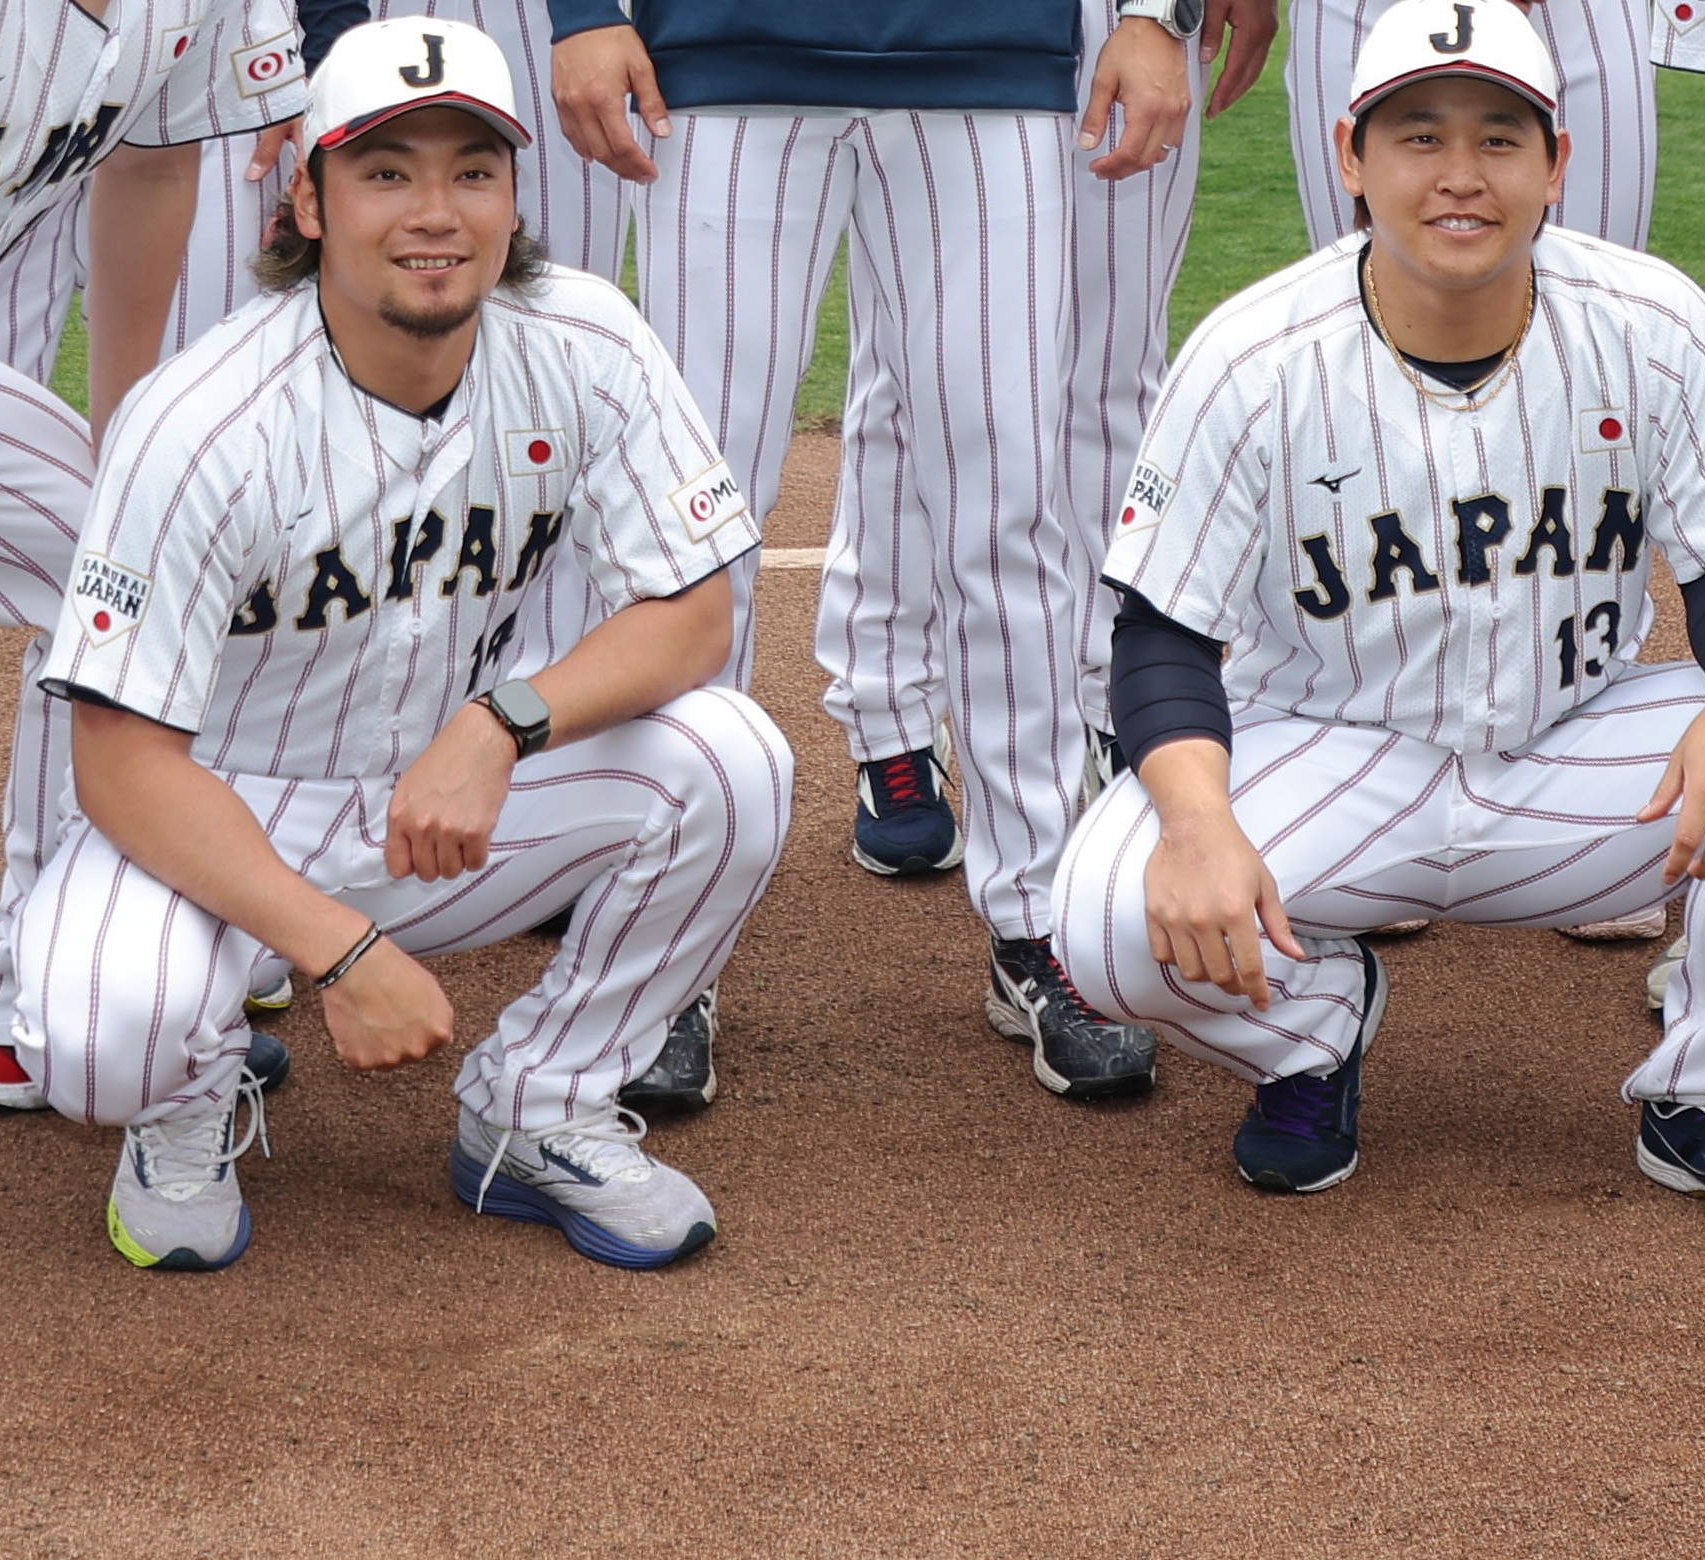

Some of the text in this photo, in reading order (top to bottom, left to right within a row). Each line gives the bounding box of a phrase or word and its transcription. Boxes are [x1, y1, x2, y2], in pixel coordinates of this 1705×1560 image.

[1429, 2, 1475, 55] J
[399, 33, 447, 89] J
[81, 558, 147, 596] SAMURAI
[1293, 484, 1648, 623] JAPAN
[76, 575, 143, 619] JAPAN
[1555, 601, 1623, 691] 13
